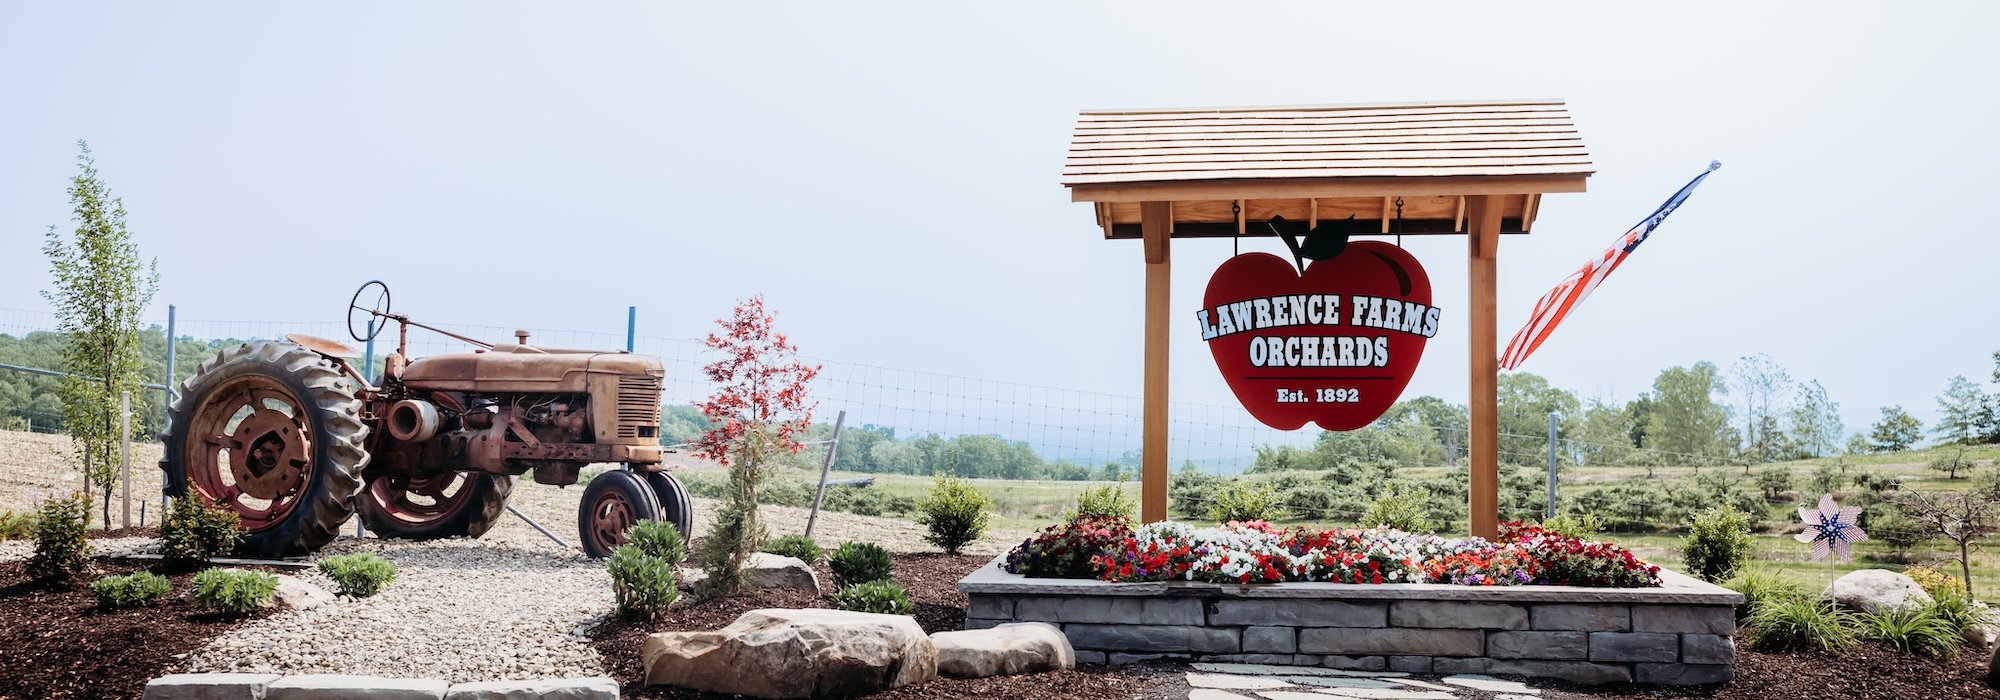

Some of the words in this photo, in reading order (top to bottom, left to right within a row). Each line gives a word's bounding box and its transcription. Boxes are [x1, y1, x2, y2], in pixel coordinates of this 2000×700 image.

[1197, 294, 1340, 341] LAWRENCE
[1351, 295, 1441, 338] FARMS
[1249, 336, 1389, 367] ORCHARDS
[1276, 388, 1308, 403] Est.
[1316, 388, 1359, 403] 1892
